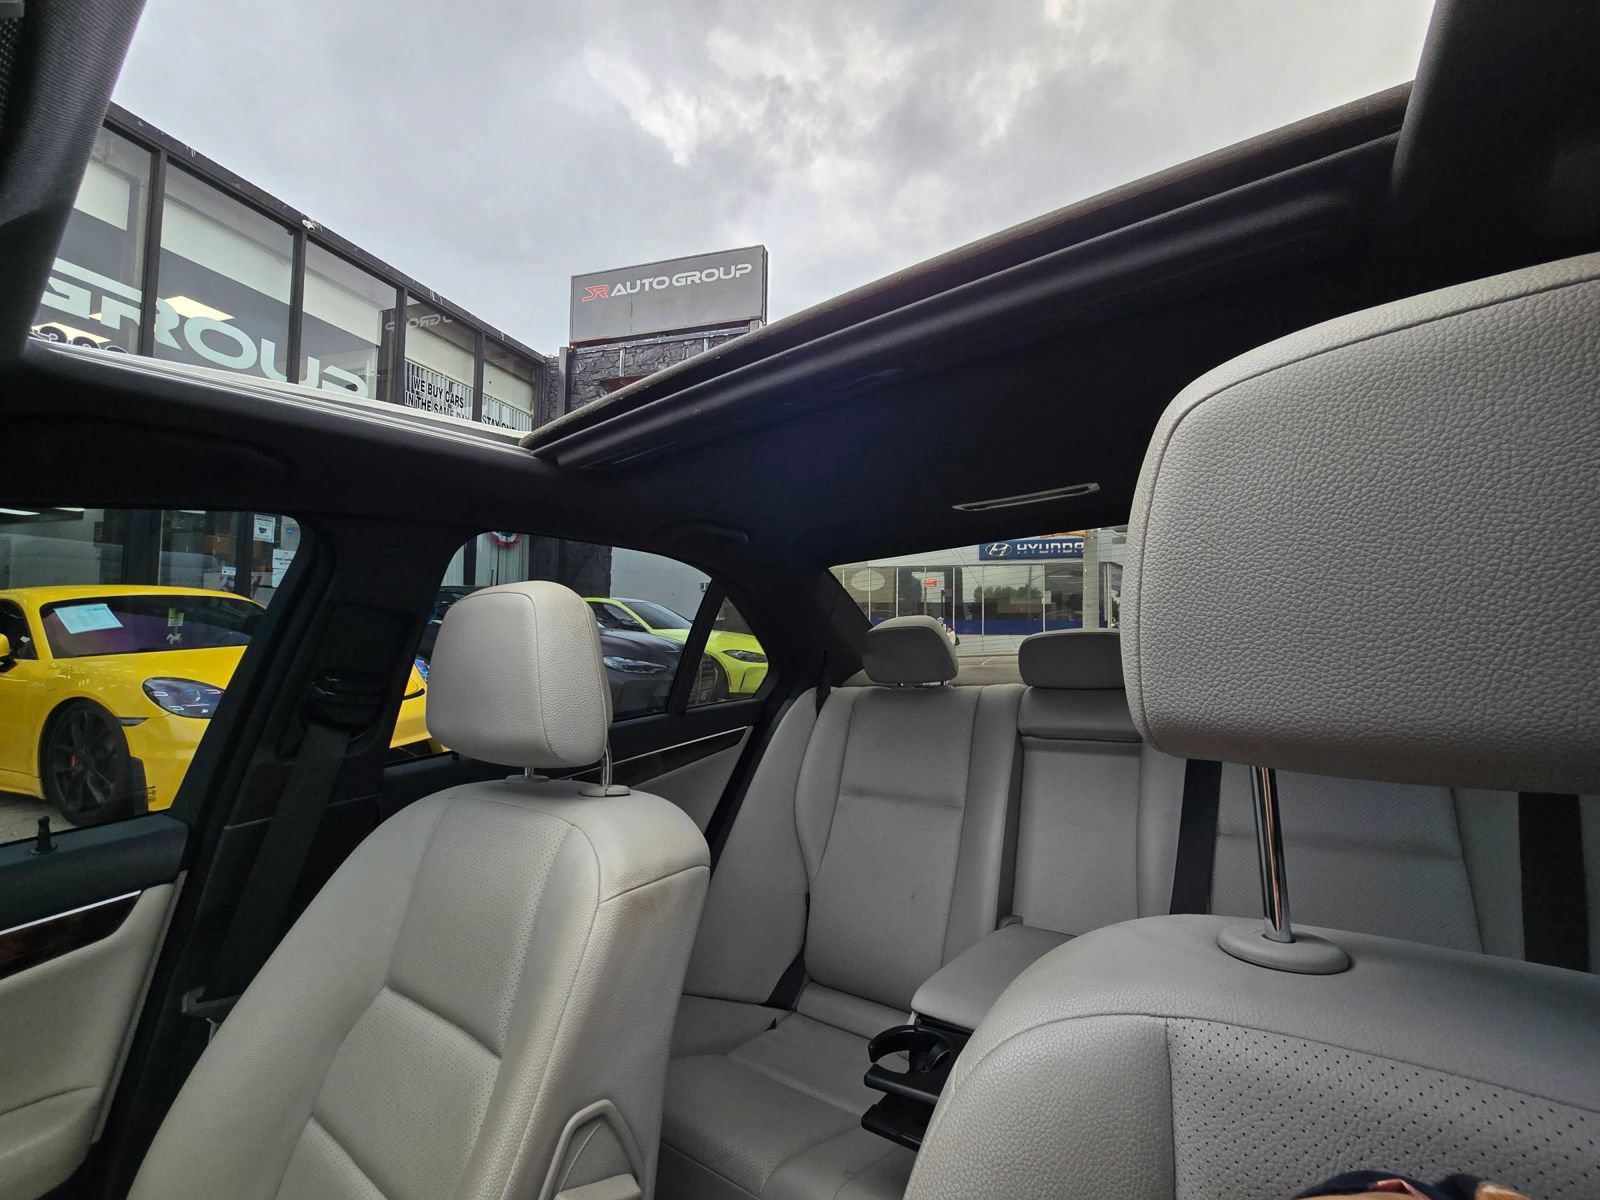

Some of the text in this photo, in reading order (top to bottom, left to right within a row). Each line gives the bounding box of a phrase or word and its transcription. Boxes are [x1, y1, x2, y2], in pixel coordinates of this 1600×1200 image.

[610, 276, 670, 297] AUTO
[672, 263, 752, 287] GROUP
[405, 391, 414, 406] IN
[415, 396, 432, 412] THE
[413, 376, 464, 409] WE BUY CARS
[1016, 541, 1085, 554] HYUNDA
